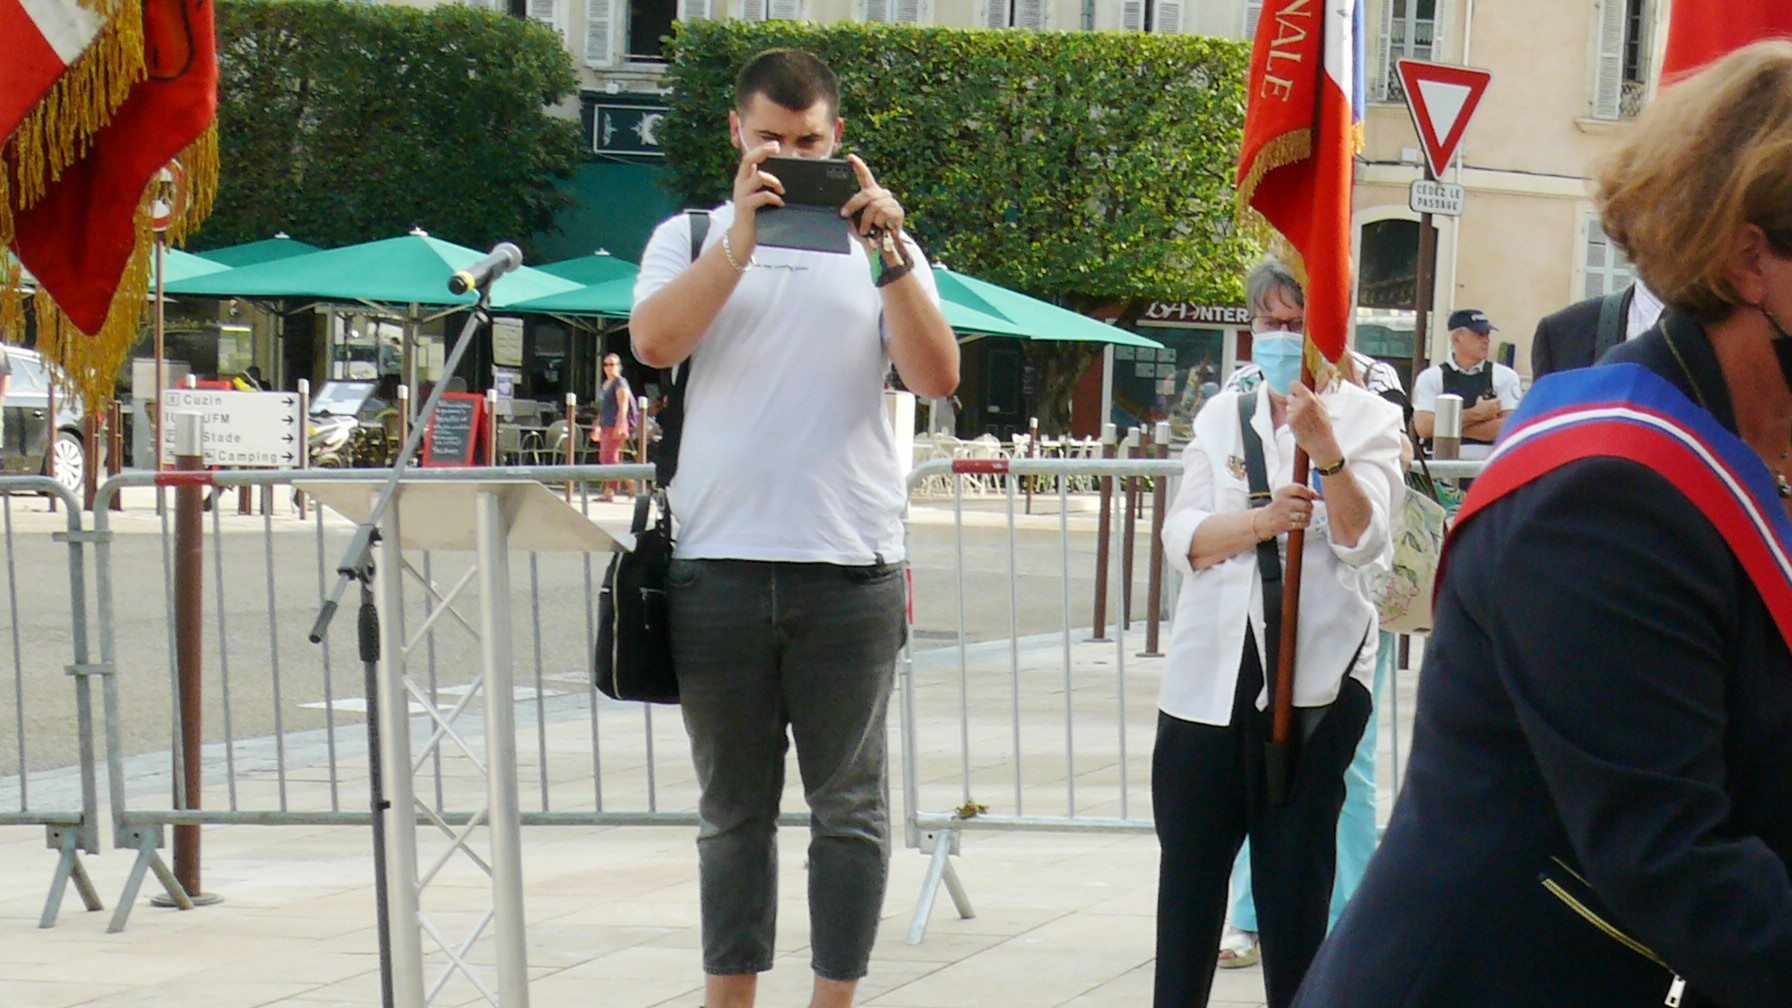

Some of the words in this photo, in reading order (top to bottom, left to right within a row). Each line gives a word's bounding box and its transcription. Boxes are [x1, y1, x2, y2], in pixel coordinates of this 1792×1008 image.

[1450, 189, 1460, 199] LE
[1417, 197, 1458, 211] PASSAGE
[183, 394, 222, 405] Cuzin
[202, 432, 241, 443] Stade
[218, 451, 278, 463] Camping
